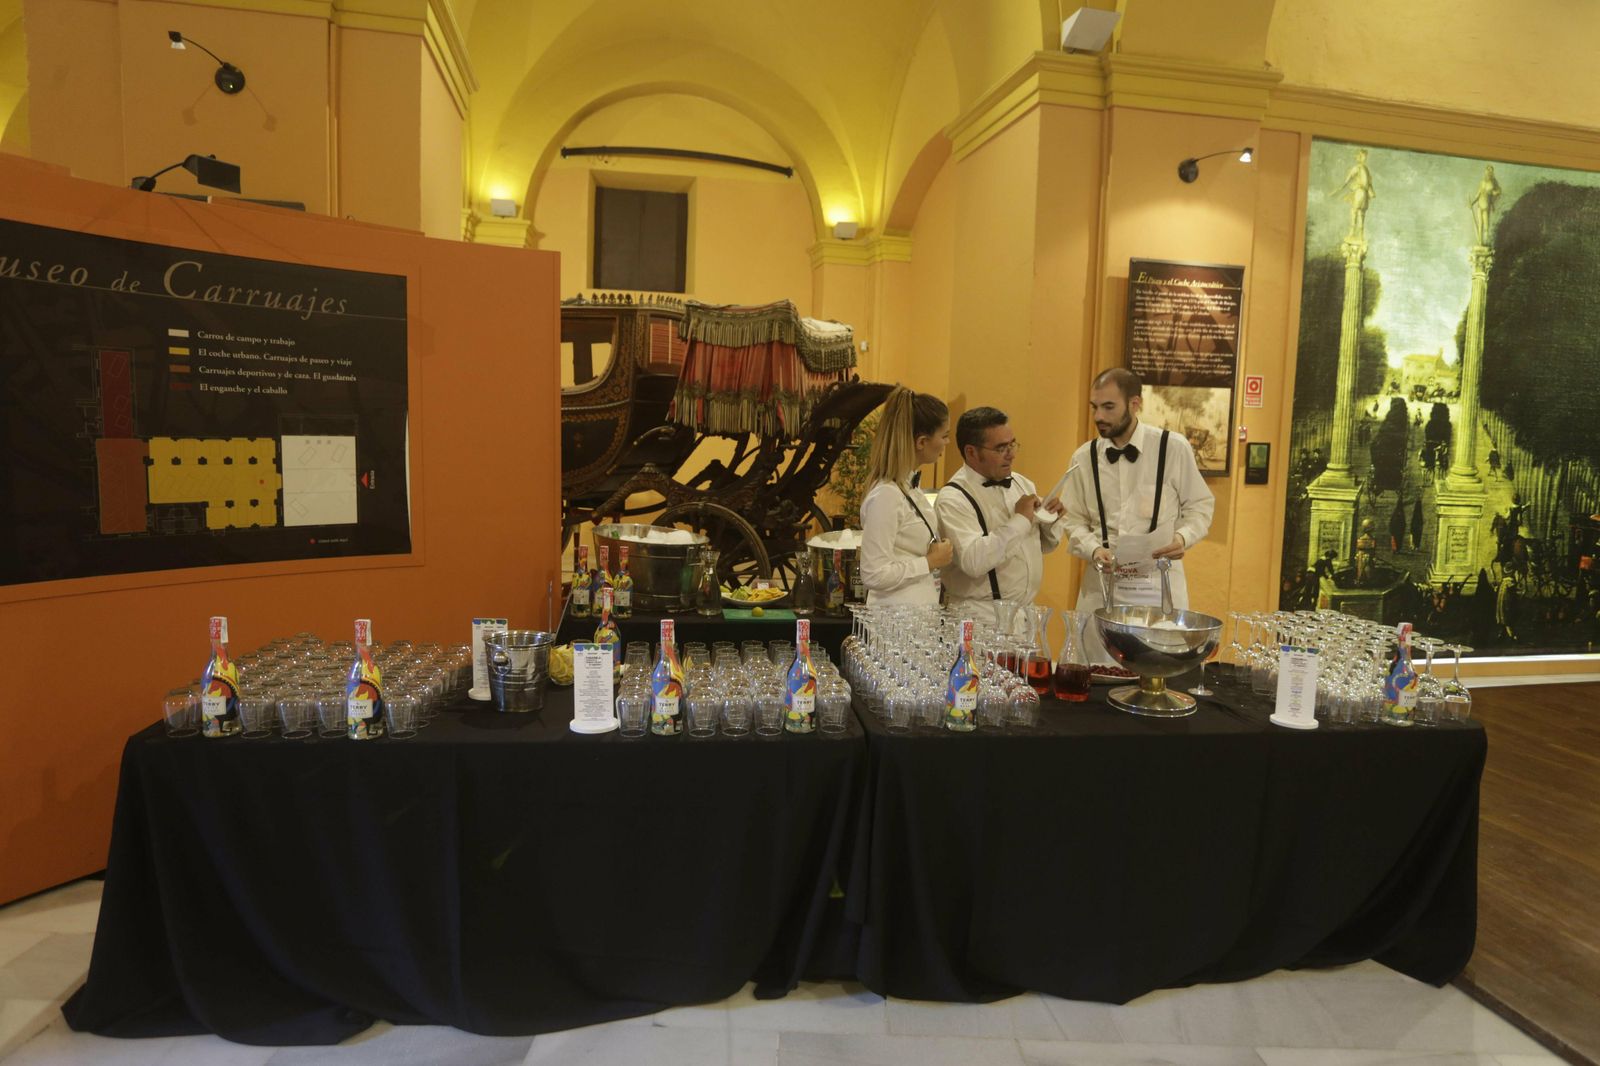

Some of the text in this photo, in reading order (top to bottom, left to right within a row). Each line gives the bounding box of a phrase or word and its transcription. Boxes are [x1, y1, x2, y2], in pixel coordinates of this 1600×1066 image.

[111, 270, 141, 292] de
[163, 260, 348, 320] Carruajes
[197, 330, 296, 347] Carros de campo y trabajo
[198, 348, 353, 367] El coche urbano. Carruajes de paseo y viaje
[198, 365, 236, 376] Carruajes
[237, 367, 276, 379] deportivos
[284, 370, 293, 378] de
[294, 372, 311, 380] caza.
[313, 371, 321, 380] El
[322, 372, 357, 382] guadarnés
[199, 383, 208, 391] El
[209, 384, 246, 394] enganche
[253, 385, 261, 393] el
[262, 386, 288, 395] caballo
